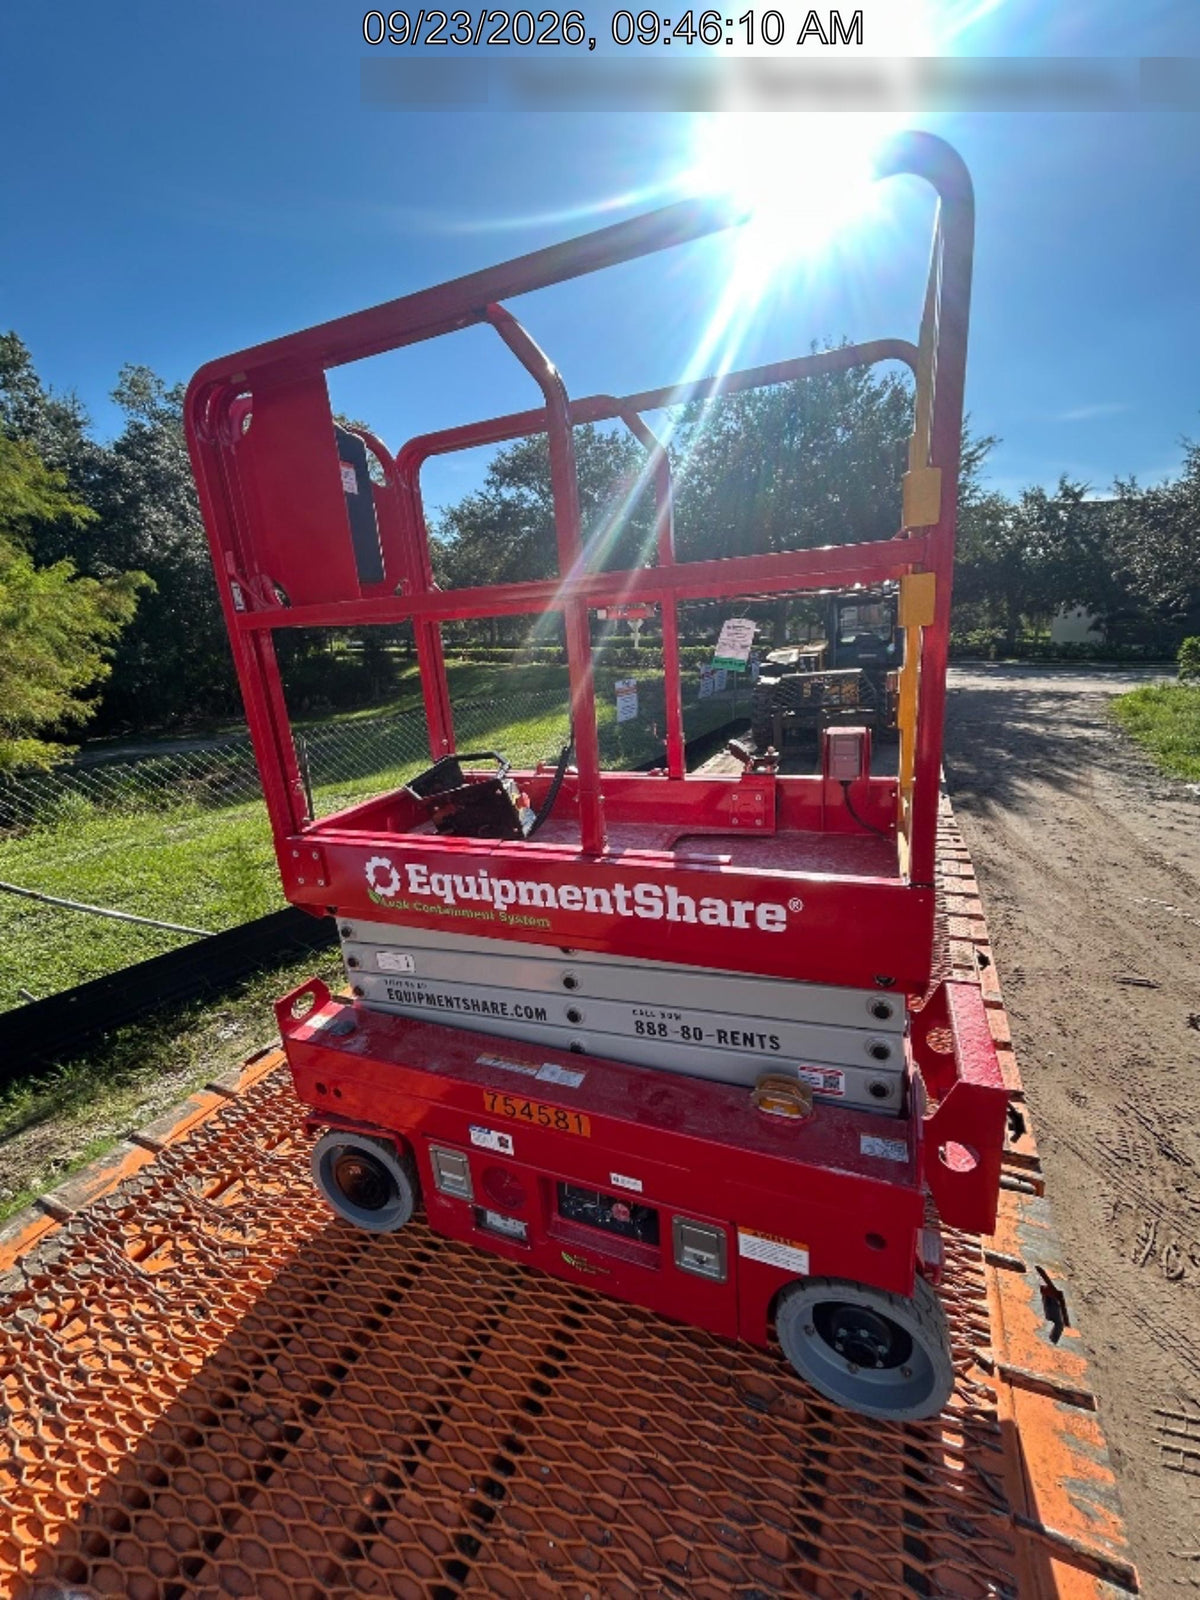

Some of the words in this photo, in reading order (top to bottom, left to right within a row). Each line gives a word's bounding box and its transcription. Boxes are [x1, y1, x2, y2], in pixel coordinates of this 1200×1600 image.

[413, 903, 495, 921] Containment
[498, 911, 551, 928] System
[386, 988, 548, 1021] EQUIPMENTSHARE.COM
[632, 1009, 656, 1019] CALL
[634, 1020, 781, 1051] 888-80-RENTS
[486, 1089, 584, 1134] 754581
